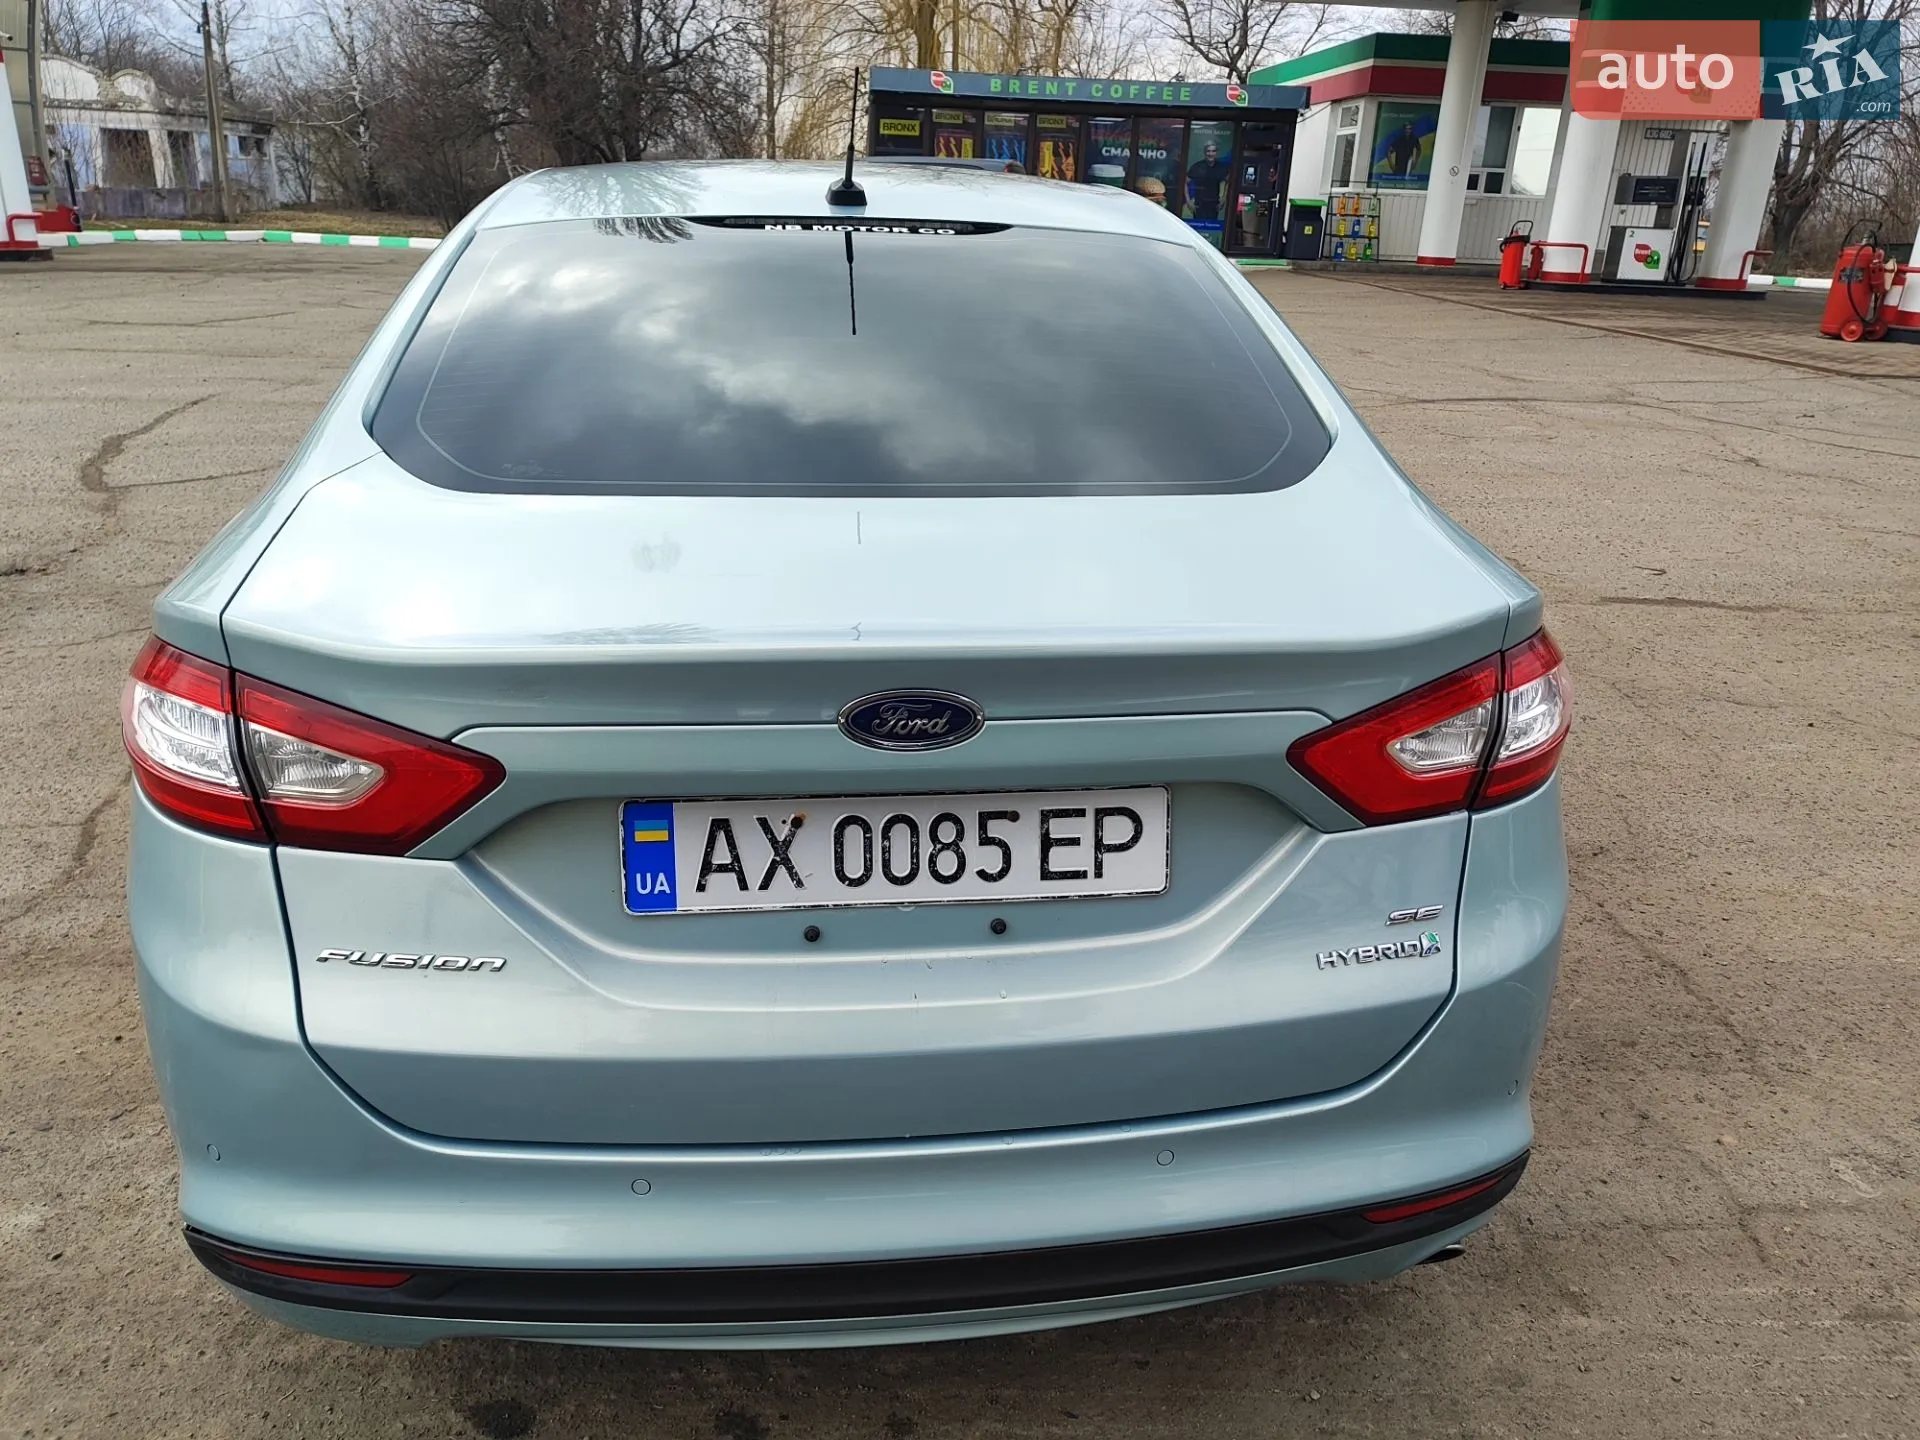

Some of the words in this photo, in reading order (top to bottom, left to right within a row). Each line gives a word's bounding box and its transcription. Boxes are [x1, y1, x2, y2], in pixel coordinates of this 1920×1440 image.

[990, 78, 1077, 96] BRENT
[1091, 83, 1192, 101] COFFEE
[882, 121, 917, 133] BRONX
[812, 224, 911, 234] MOTOR
[1629, 230, 1635, 238] 2
[871, 702, 952, 736] Ford
[694, 812, 807, 893] AX
[831, 809, 1014, 888] 0085
[1039, 805, 1145, 882] EP
[635, 872, 671, 896] UA
[1384, 903, 1445, 927] SE
[316, 947, 507, 972] FUSION
[1316, 939, 1420, 970] HYBRID
